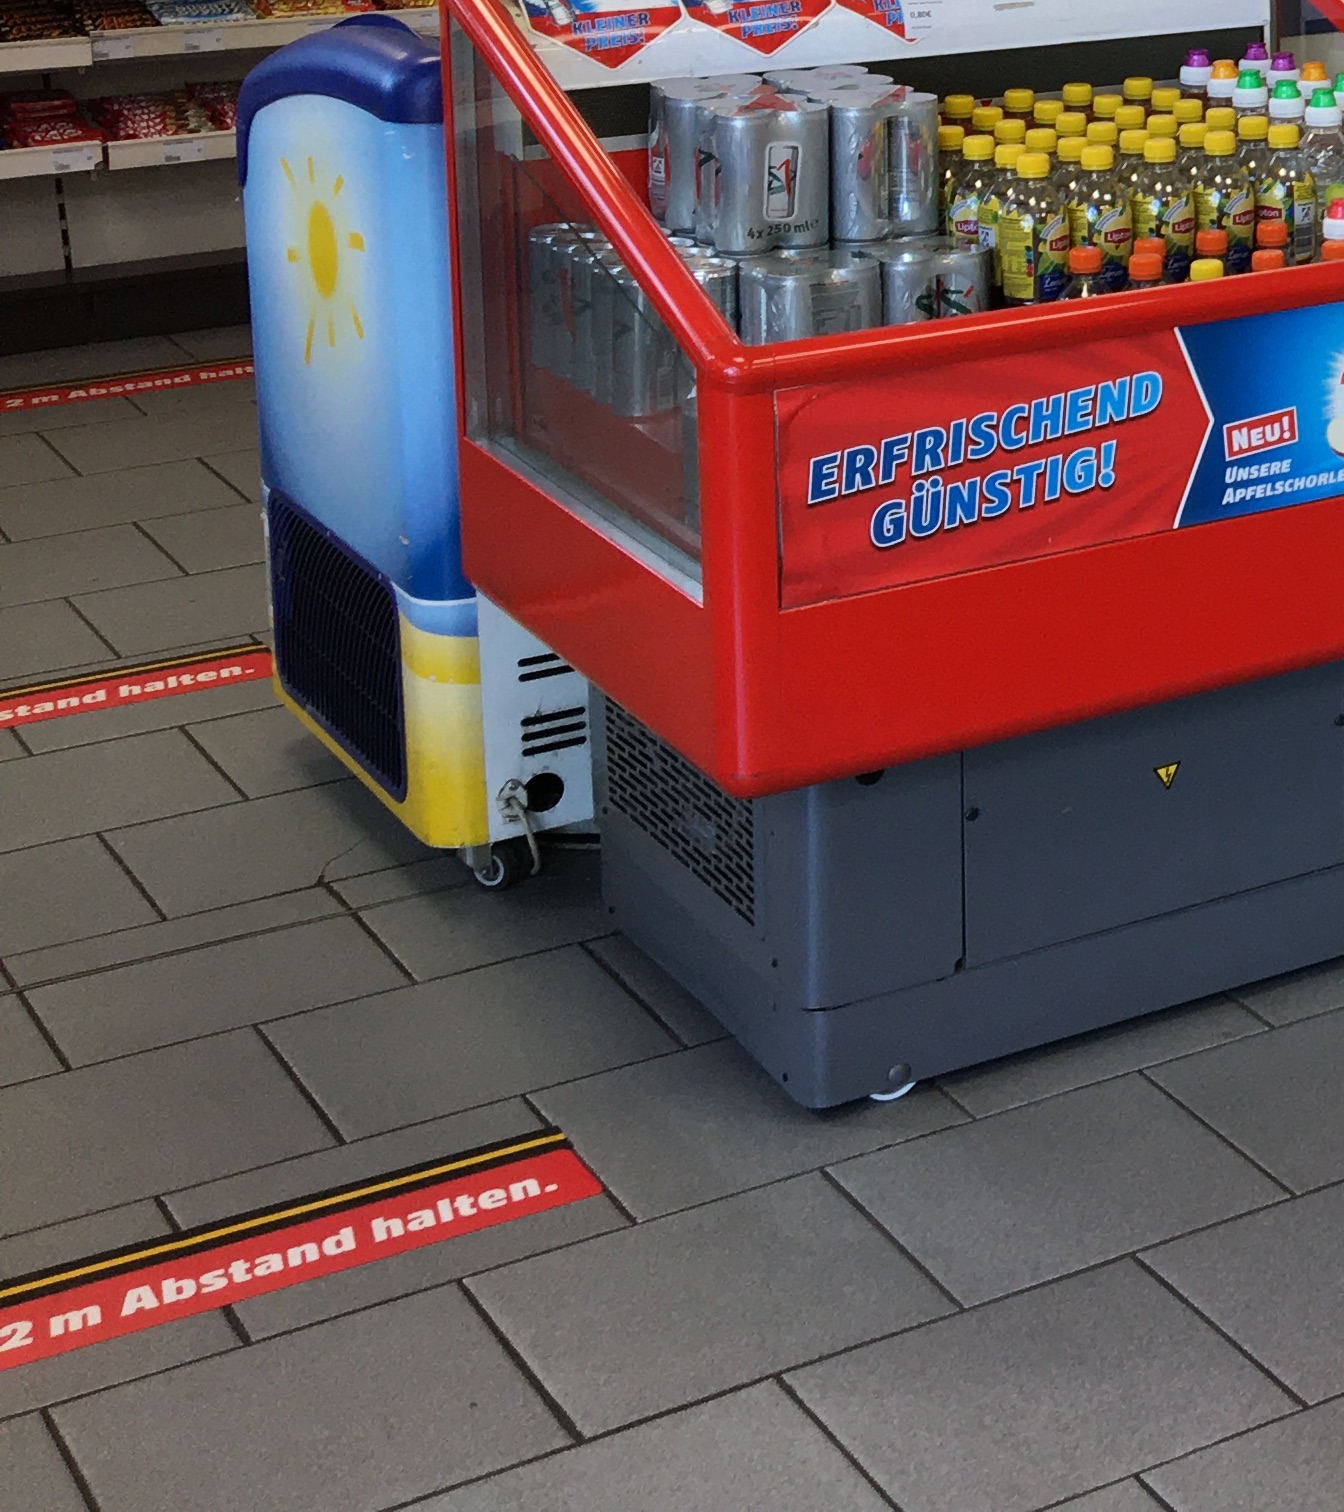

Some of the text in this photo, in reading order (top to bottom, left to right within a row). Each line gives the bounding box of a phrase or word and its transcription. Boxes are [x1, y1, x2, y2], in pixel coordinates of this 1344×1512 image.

[572, 12, 650, 36] KLEINER
[728, 0, 802, 24] KLEINER
[741, 16, 798, 39] PREIS!
[585, 29, 646, 52] PREIS!
[747, 220, 809, 240] 4x 250 ml
[5, 365, 255, 408] 2 m Abstand halt
[807, 371, 1164, 504] ERFRISCHEND
[870, 440, 1118, 548] GÜNSTIG!
[0, 664, 256, 722] stand halten.
[0, 1175, 559, 1352] 2 m Abstand halten.
